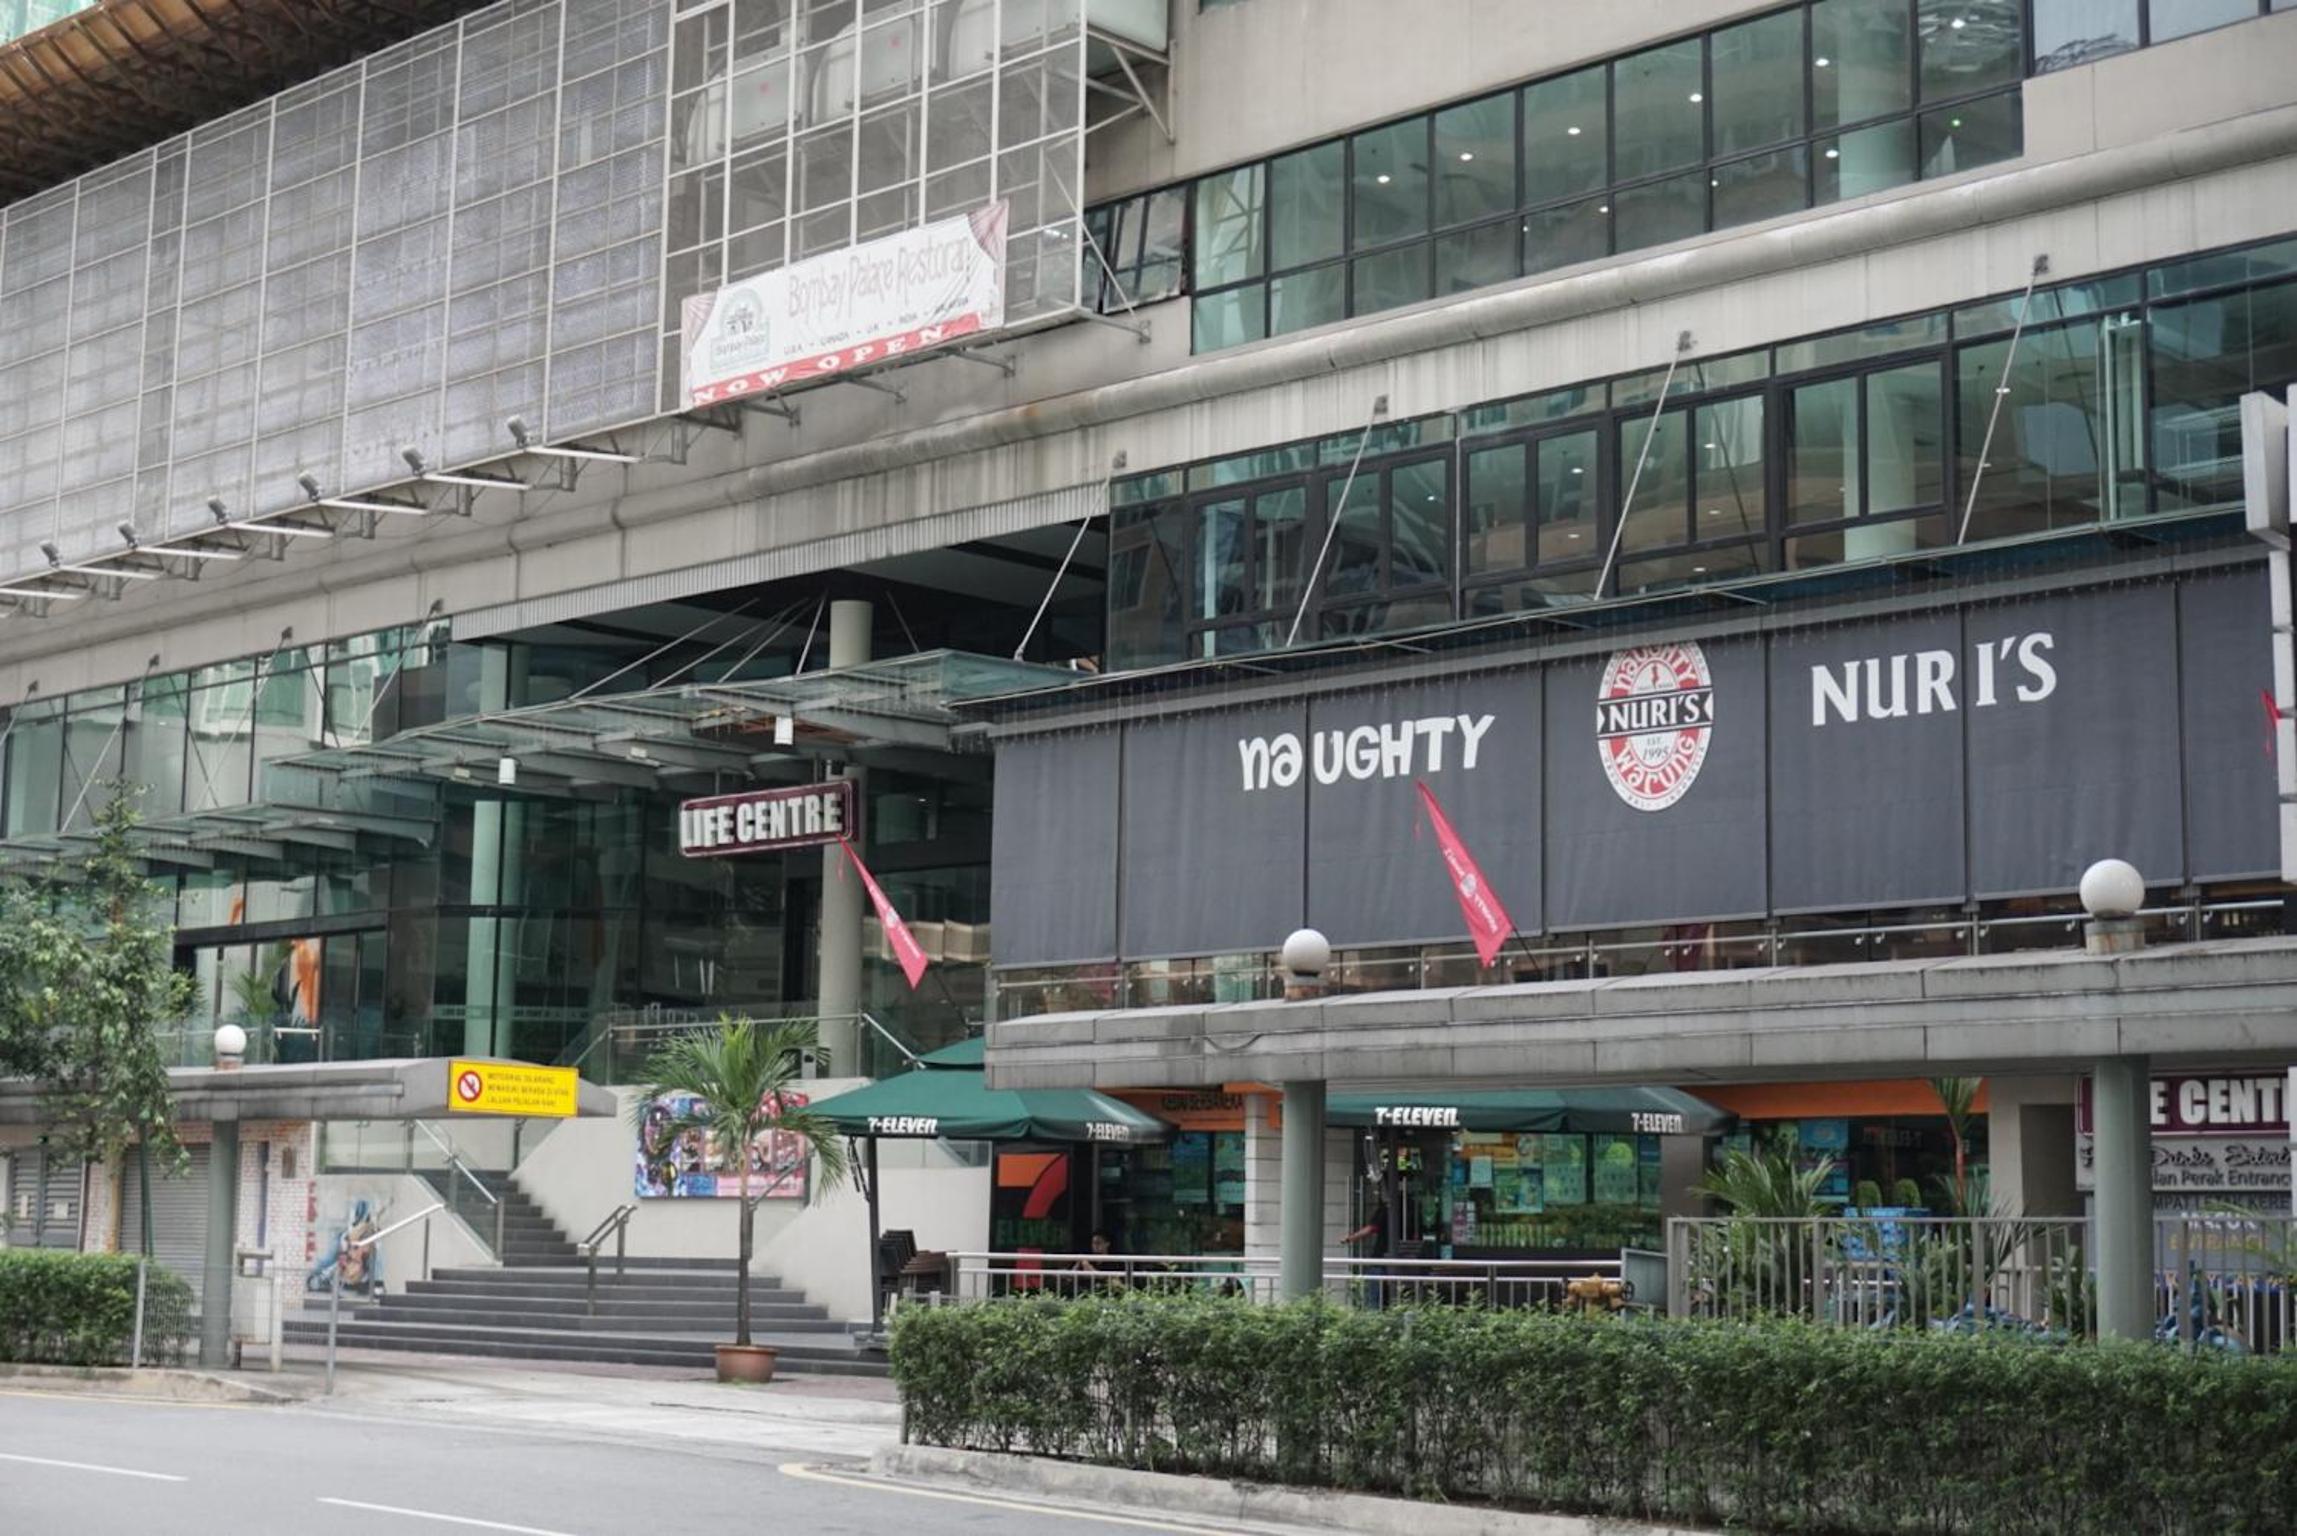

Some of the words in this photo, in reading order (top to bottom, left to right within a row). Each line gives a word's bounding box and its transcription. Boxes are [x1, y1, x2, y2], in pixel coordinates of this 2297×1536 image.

[788, 265, 848, 323] Bombay
[849, 252, 894, 318] Palace
[693, 367, 788, 408] NOW
[817, 325, 944, 372] OPEN
[1810, 632, 2057, 726] NURI'S
[1609, 694, 1700, 732] NURI'S
[680, 806, 734, 848] LIFE
[736, 792, 842, 842] CENTRE
[2178, 1077, 2288, 1124] CENT
[2153, 1168, 2177, 1186] lan
[2182, 1169, 2224, 1186] Perak
[2228, 1169, 2291, 1187] Entranc
